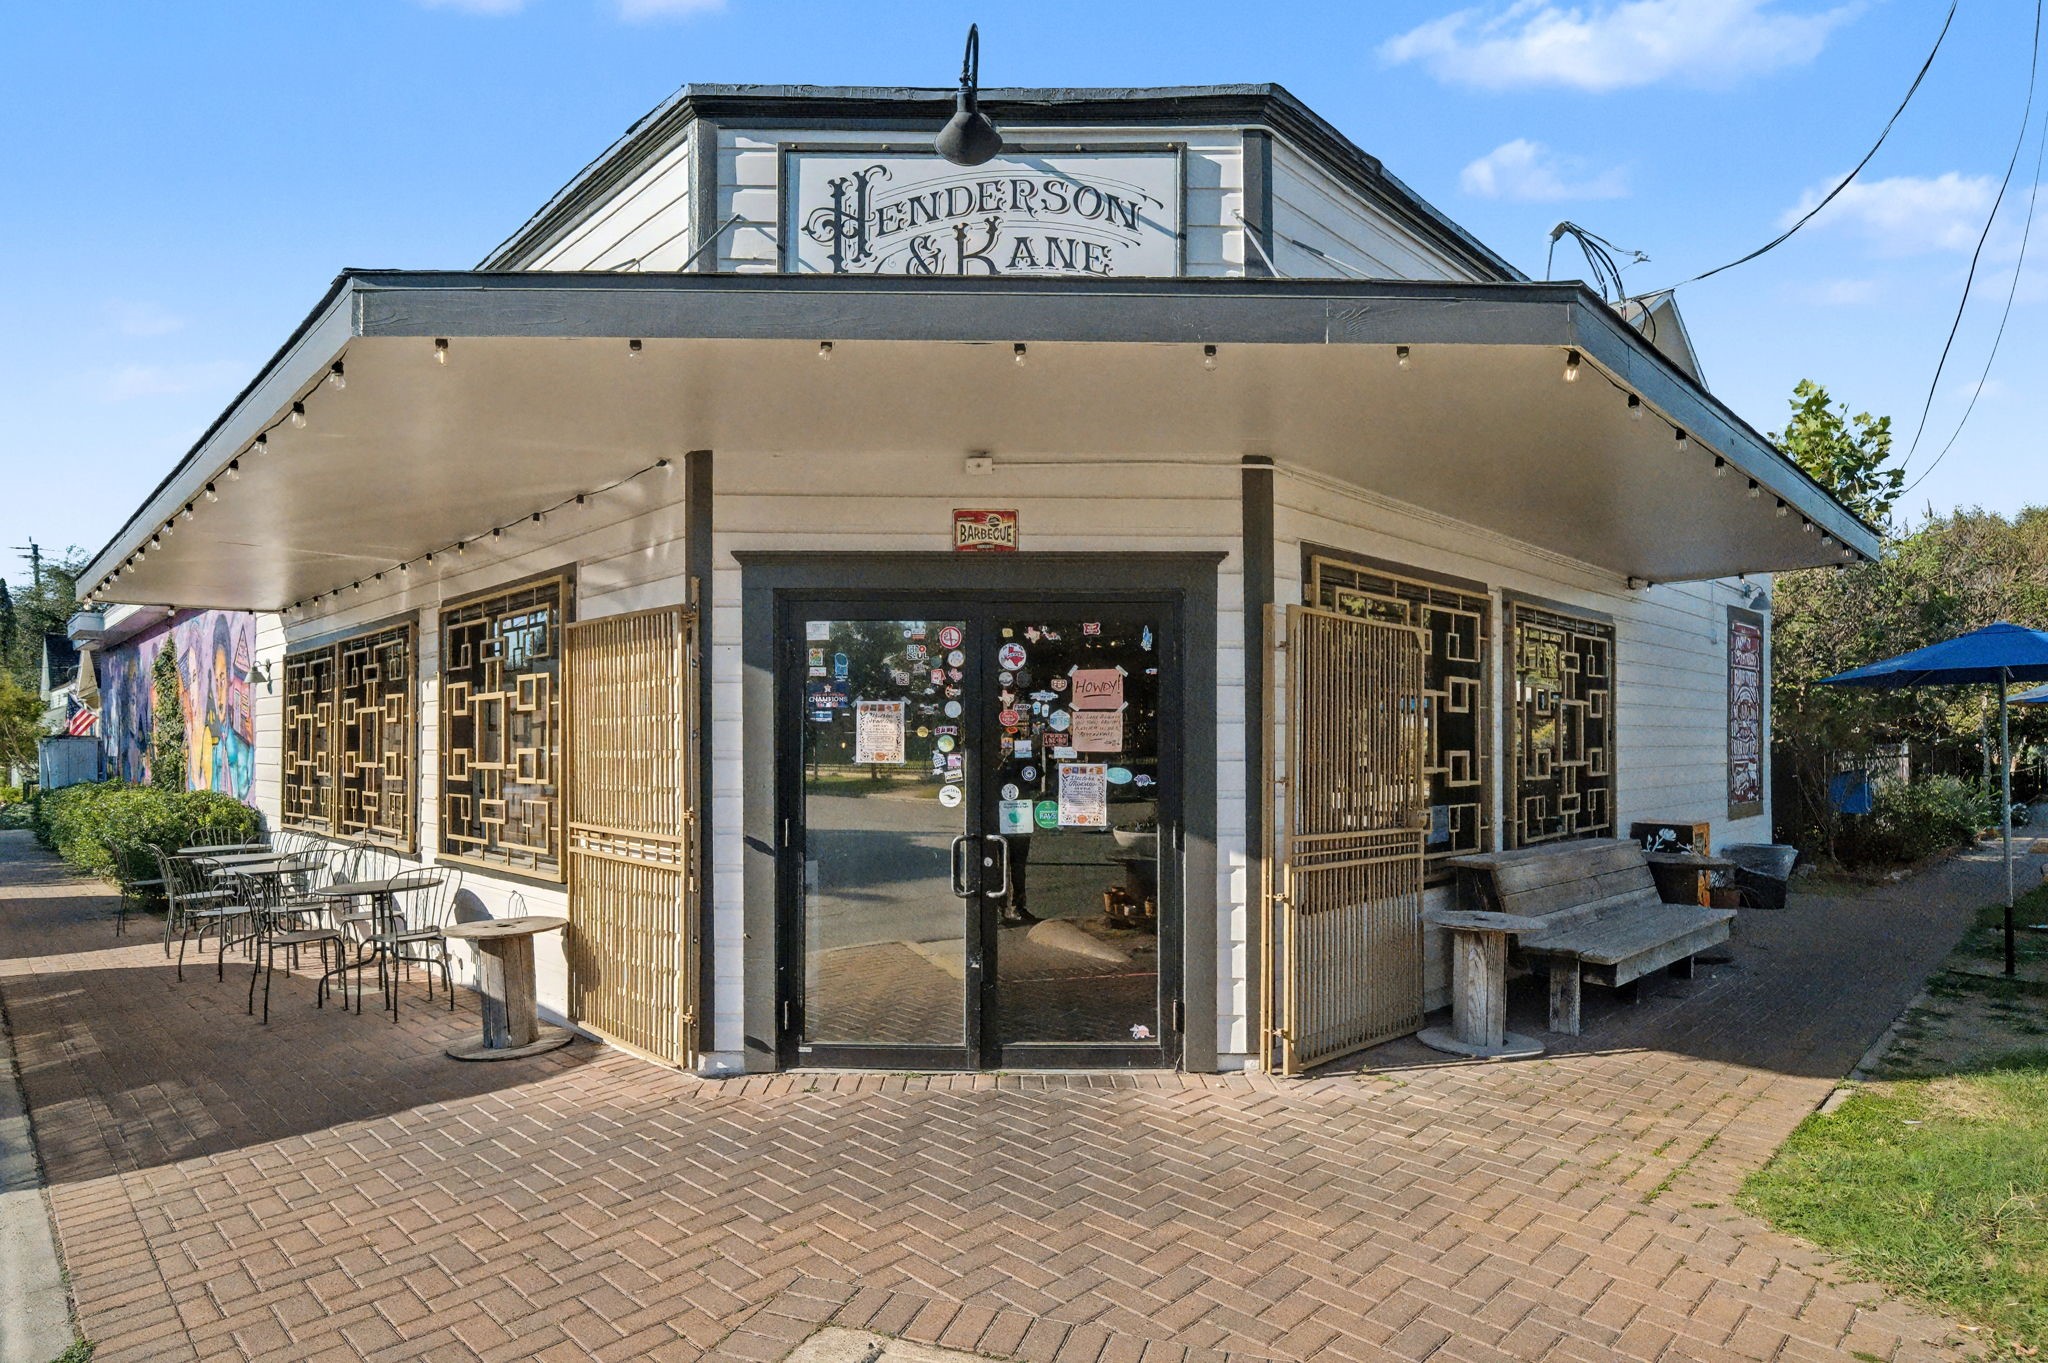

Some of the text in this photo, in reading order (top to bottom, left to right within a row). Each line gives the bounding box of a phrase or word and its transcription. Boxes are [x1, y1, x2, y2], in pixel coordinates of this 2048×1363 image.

[801, 164, 1147, 273] HENDERSON
[905, 215, 1112, 275] & KANE
[960, 524, 1012, 543] BARBECUE
[1075, 673, 1121, 694] HOWDY!
